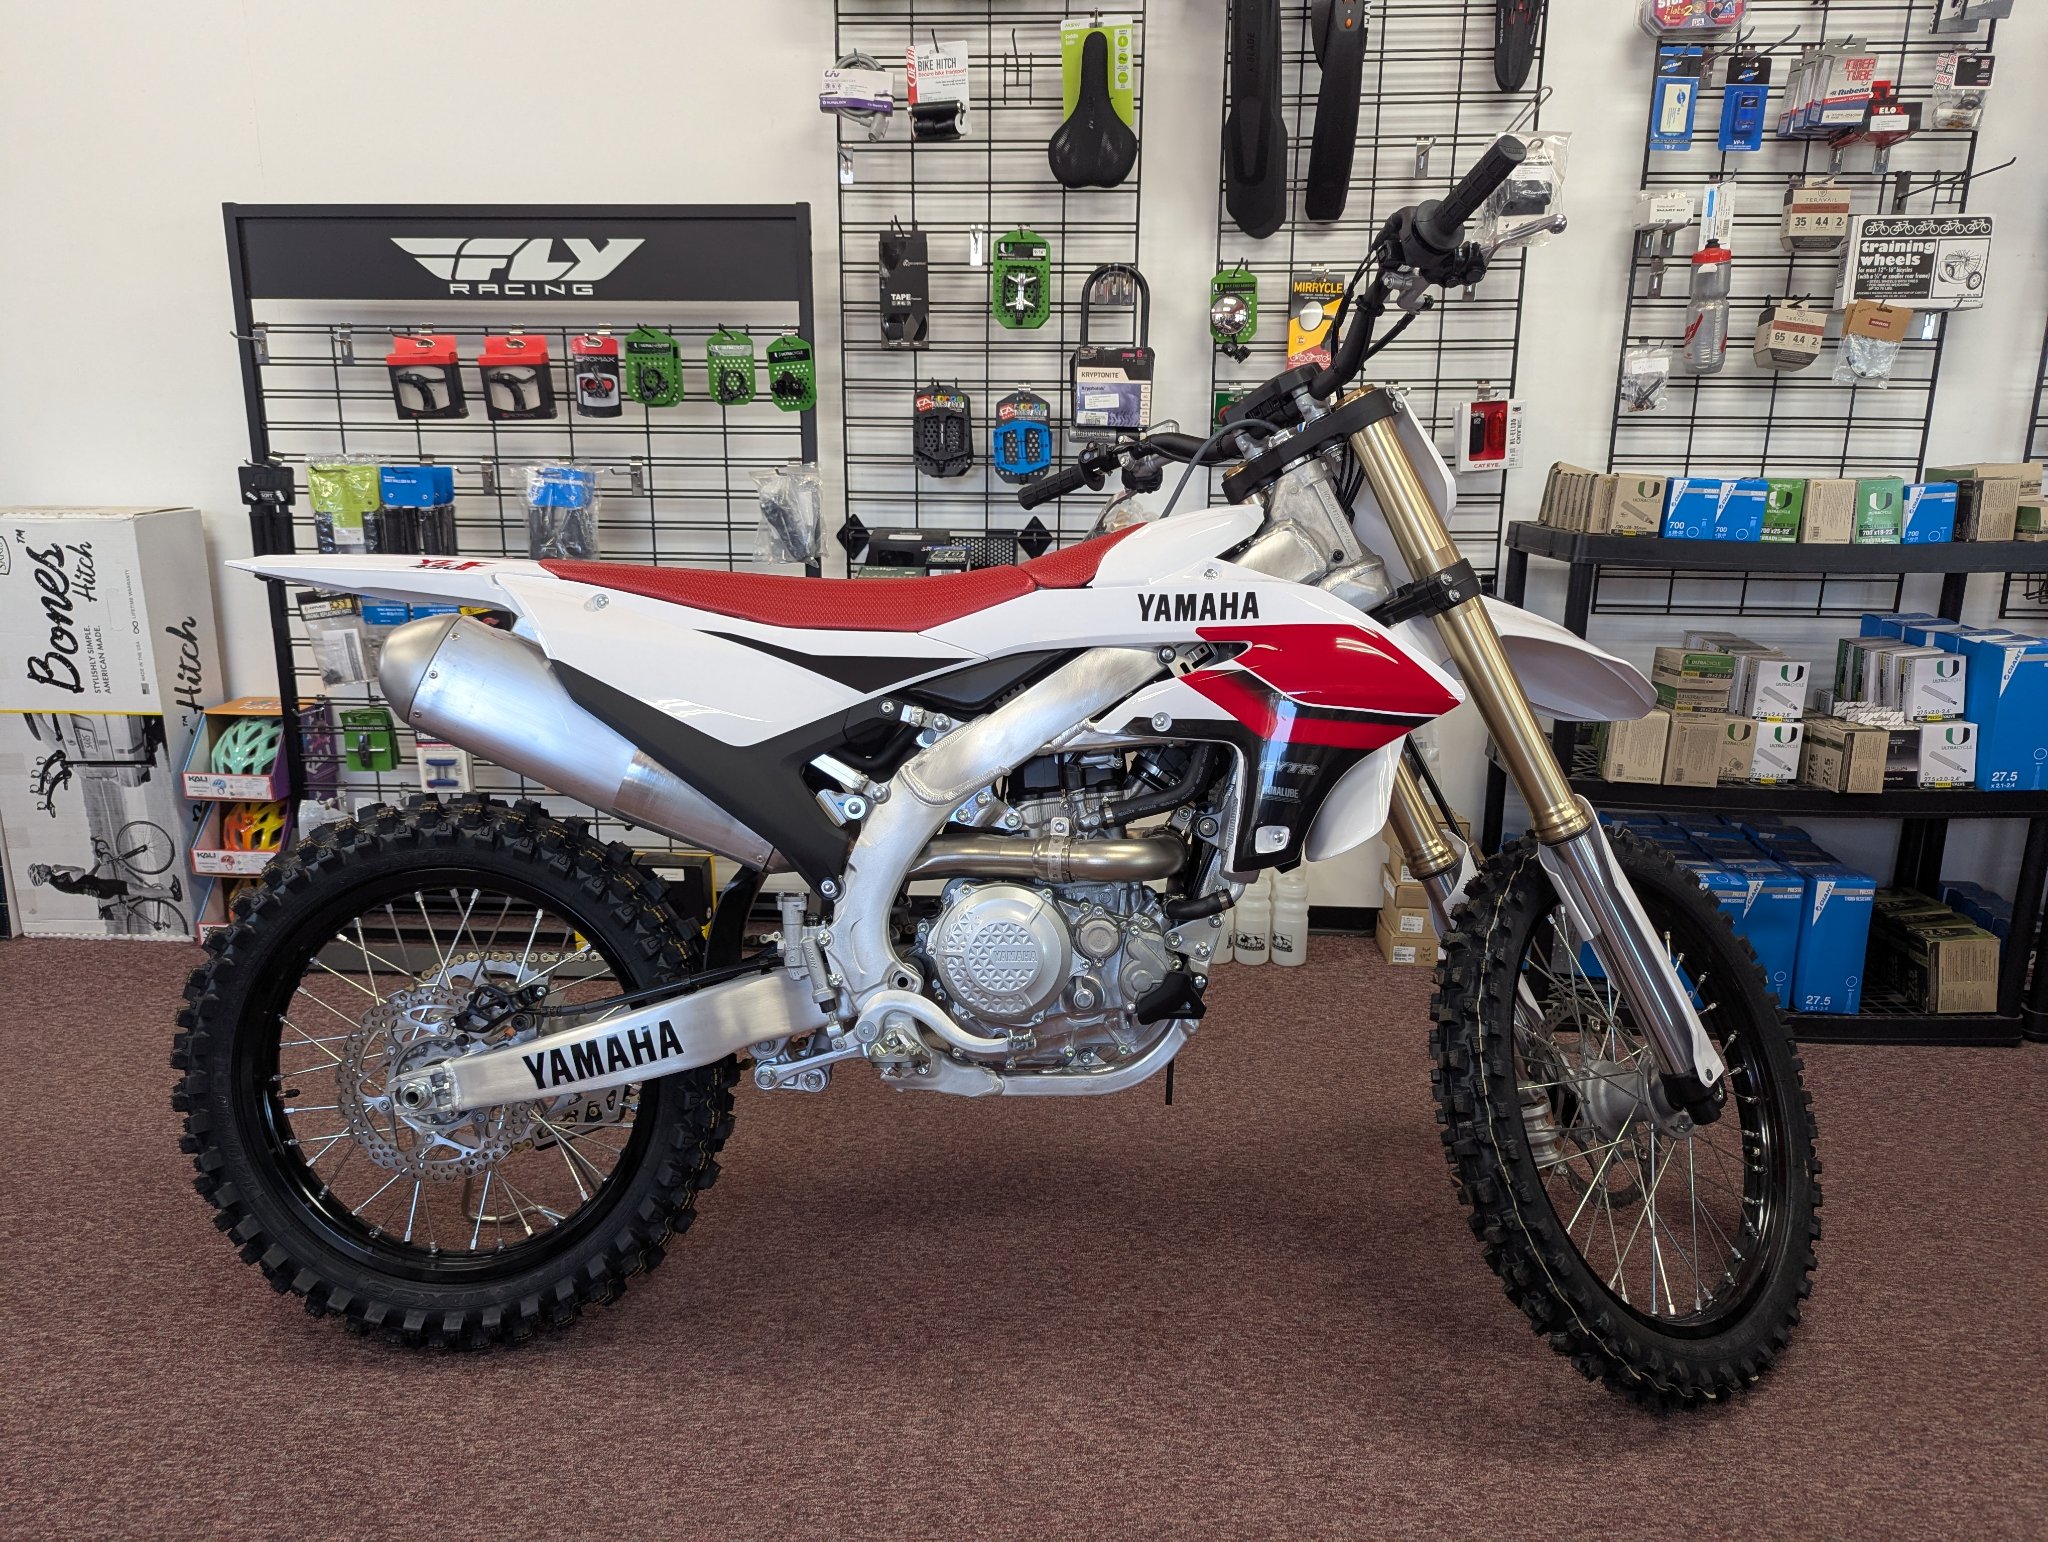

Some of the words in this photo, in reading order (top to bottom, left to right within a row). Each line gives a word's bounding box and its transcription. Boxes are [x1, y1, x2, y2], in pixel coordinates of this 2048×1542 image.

[824, 70, 840, 78] Liv
[918, 60, 934, 71] BIKE
[936, 57, 957, 70] HITCH
[1846, 58, 1877, 70] INNER
[1846, 70, 1874, 81] TUBE
[1872, 105, 1904, 115] VELOX
[1795, 216, 1807, 226] 35
[1815, 216, 1829, 227] 4.4
[1861, 240, 1936, 254] training
[391, 238, 646, 281] FLY
[1860, 253, 1921, 266] wheels
[449, 283, 594, 296] RACING
[1293, 282, 1343, 294] MIRRYCLE
[1774, 332, 1786, 341] 65
[1792, 335, 1805, 344] 4.4
[1081, 371, 1119, 379] KRYPTONITE
[1675, 482, 1688, 503] GIANT
[1722, 484, 1735, 505] GIANT
[1669, 521, 1685, 529] 700
[65, 541, 98, 603] Hitch
[125, 569, 133, 597] WARRANTY
[128, 597, 137, 619] LIFETIME
[1137, 591, 1260, 622] YAMAHA
[26, 543, 84, 694] Bones
[84, 625, 95, 654] SIMPLE.
[94, 625, 104, 650] MADE.
[166, 616, 205, 715] Hitch
[2008, 650, 2022, 675] GIANT
[88, 656, 102, 694] STYLISHLY
[98, 653, 112, 694] AMERICAN
[1992, 771, 2018, 782] 27.5
[1749, 882, 1762, 905] GIANT
[1820, 883, 1833, 907] GIANT
[993, 950, 1037, 962] YAMAHA
[1805, 995, 1831, 1006] 27.5
[522, 1020, 685, 1090] YAMAHA
